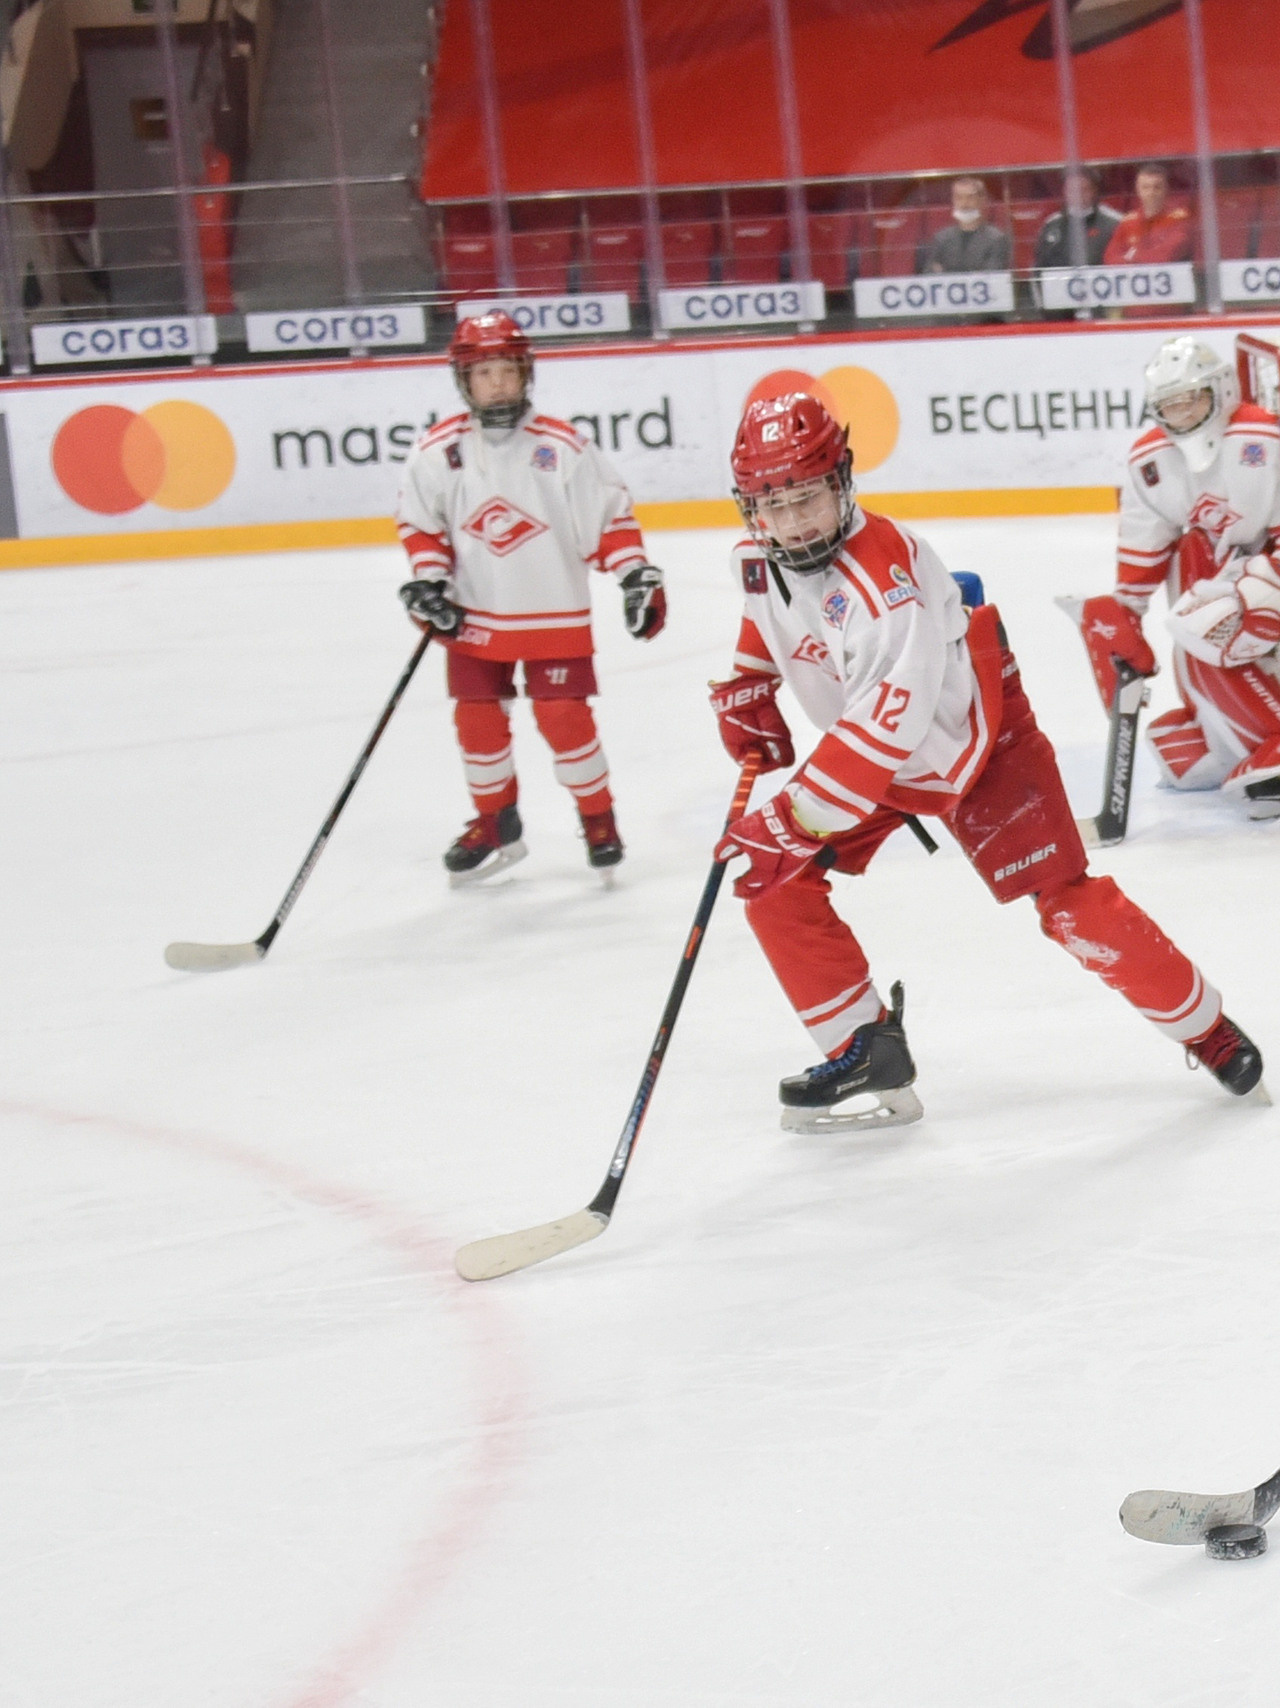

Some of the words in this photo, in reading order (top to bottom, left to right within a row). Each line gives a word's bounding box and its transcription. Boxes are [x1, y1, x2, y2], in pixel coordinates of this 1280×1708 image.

[880, 280, 991, 309] согаз
[1066, 271, 1173, 301] согаз
[487, 301, 604, 330] огаз
[685, 290, 801, 320] согаз
[62, 324, 190, 355] согаз
[276, 313, 400, 344] согаз
[272, 396, 674, 469] masard
[761, 421, 780, 442] 12
[869, 680, 911, 733] 12
[994, 842, 1057, 882] BAUER
